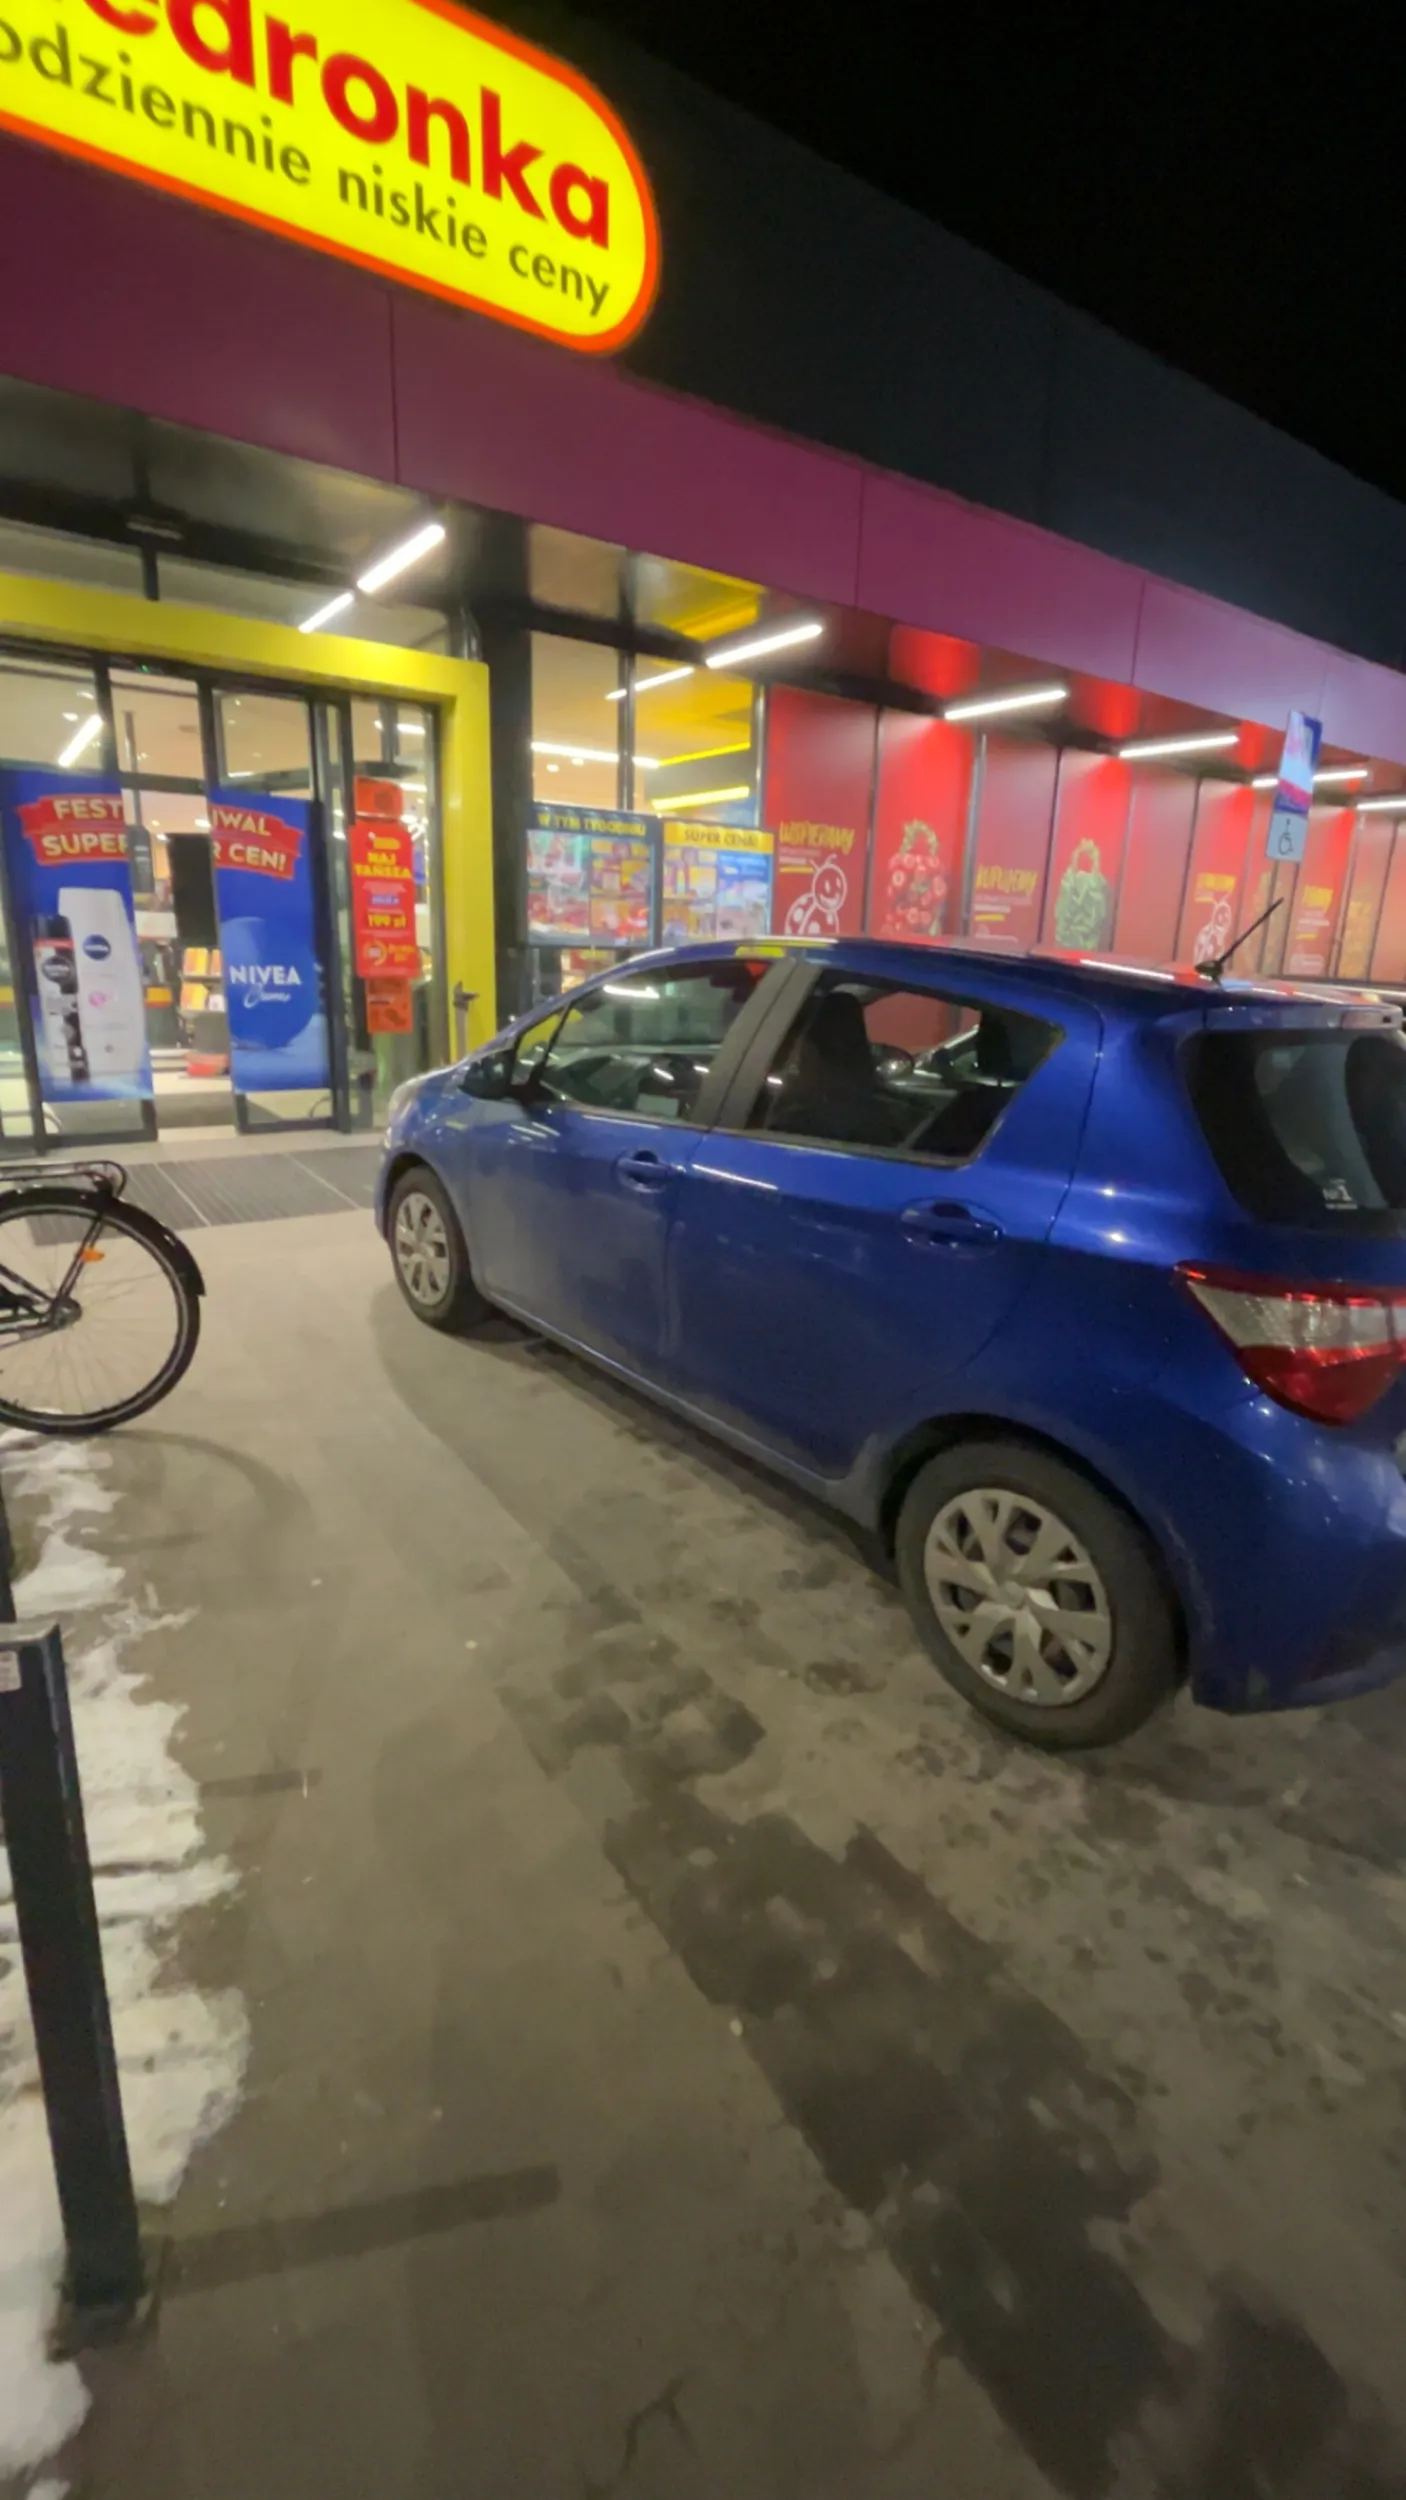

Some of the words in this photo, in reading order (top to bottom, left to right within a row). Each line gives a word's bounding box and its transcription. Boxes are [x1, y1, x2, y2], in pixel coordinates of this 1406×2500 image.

[338, 165, 488, 259] niskie
[508, 243, 610, 317] ceny
[684, 828, 720, 844] SUPER
[229, 965, 302, 986] NIVEA
